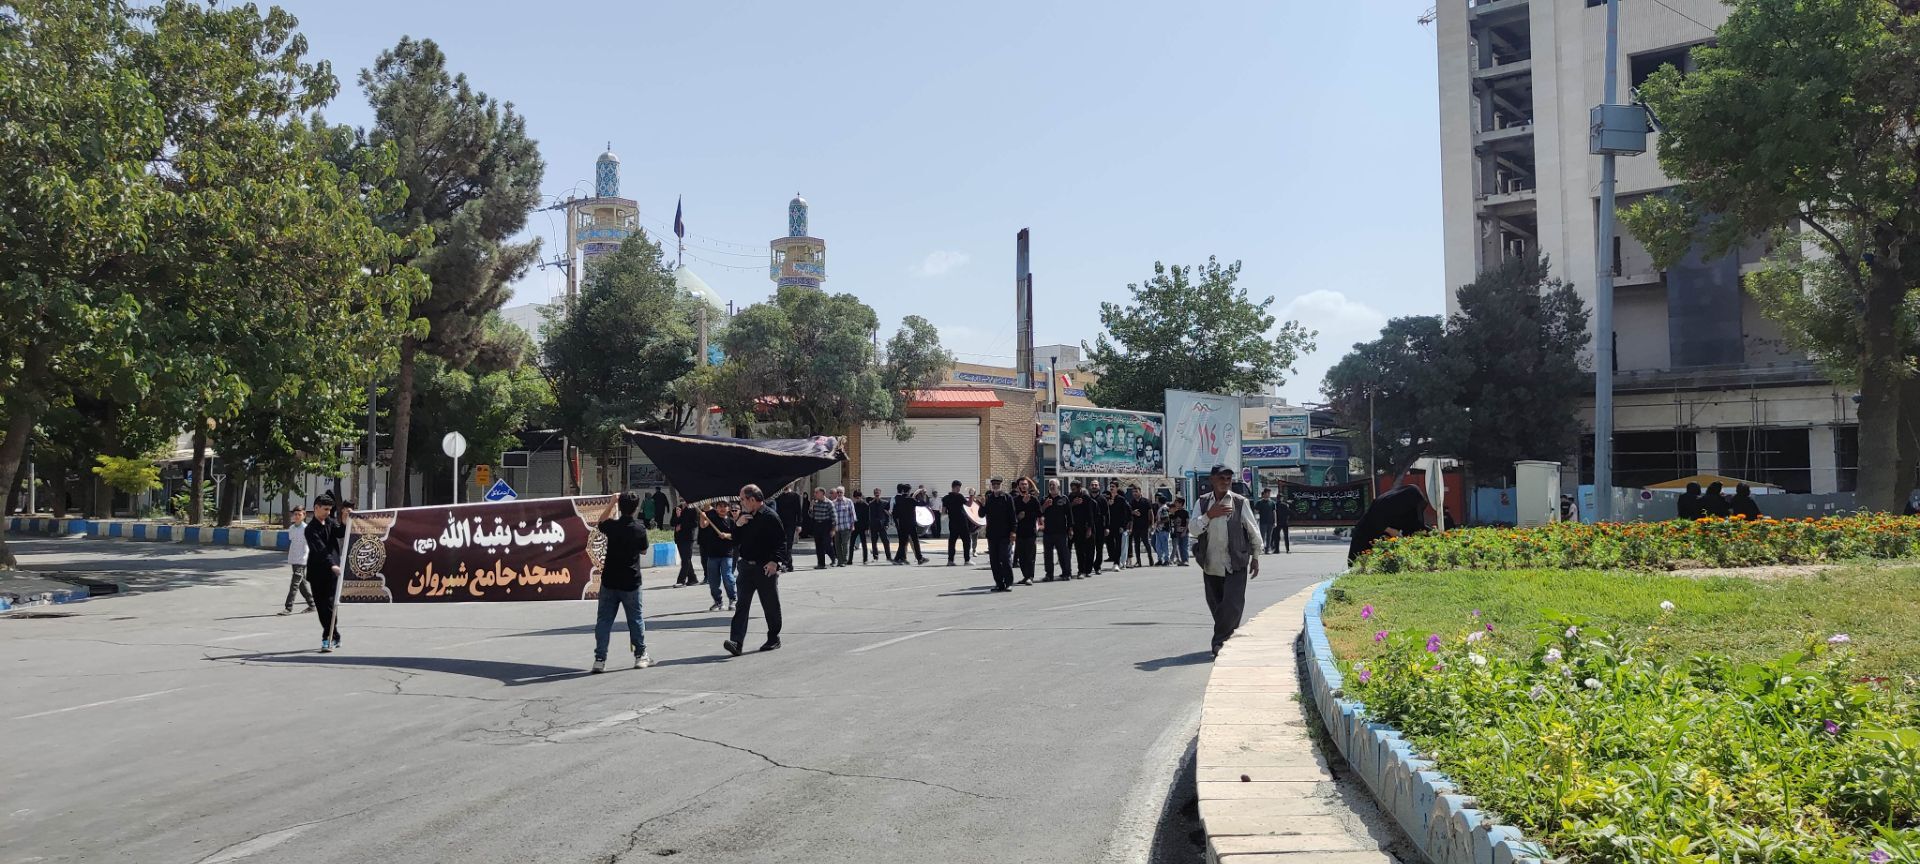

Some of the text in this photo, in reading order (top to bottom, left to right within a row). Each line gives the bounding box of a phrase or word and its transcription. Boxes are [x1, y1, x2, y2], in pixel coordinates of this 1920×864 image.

[413, 537, 437, 554] (عج)
[439, 511, 471, 548] الله
[407, 559, 571, 597] مسجد جامع شیروان
